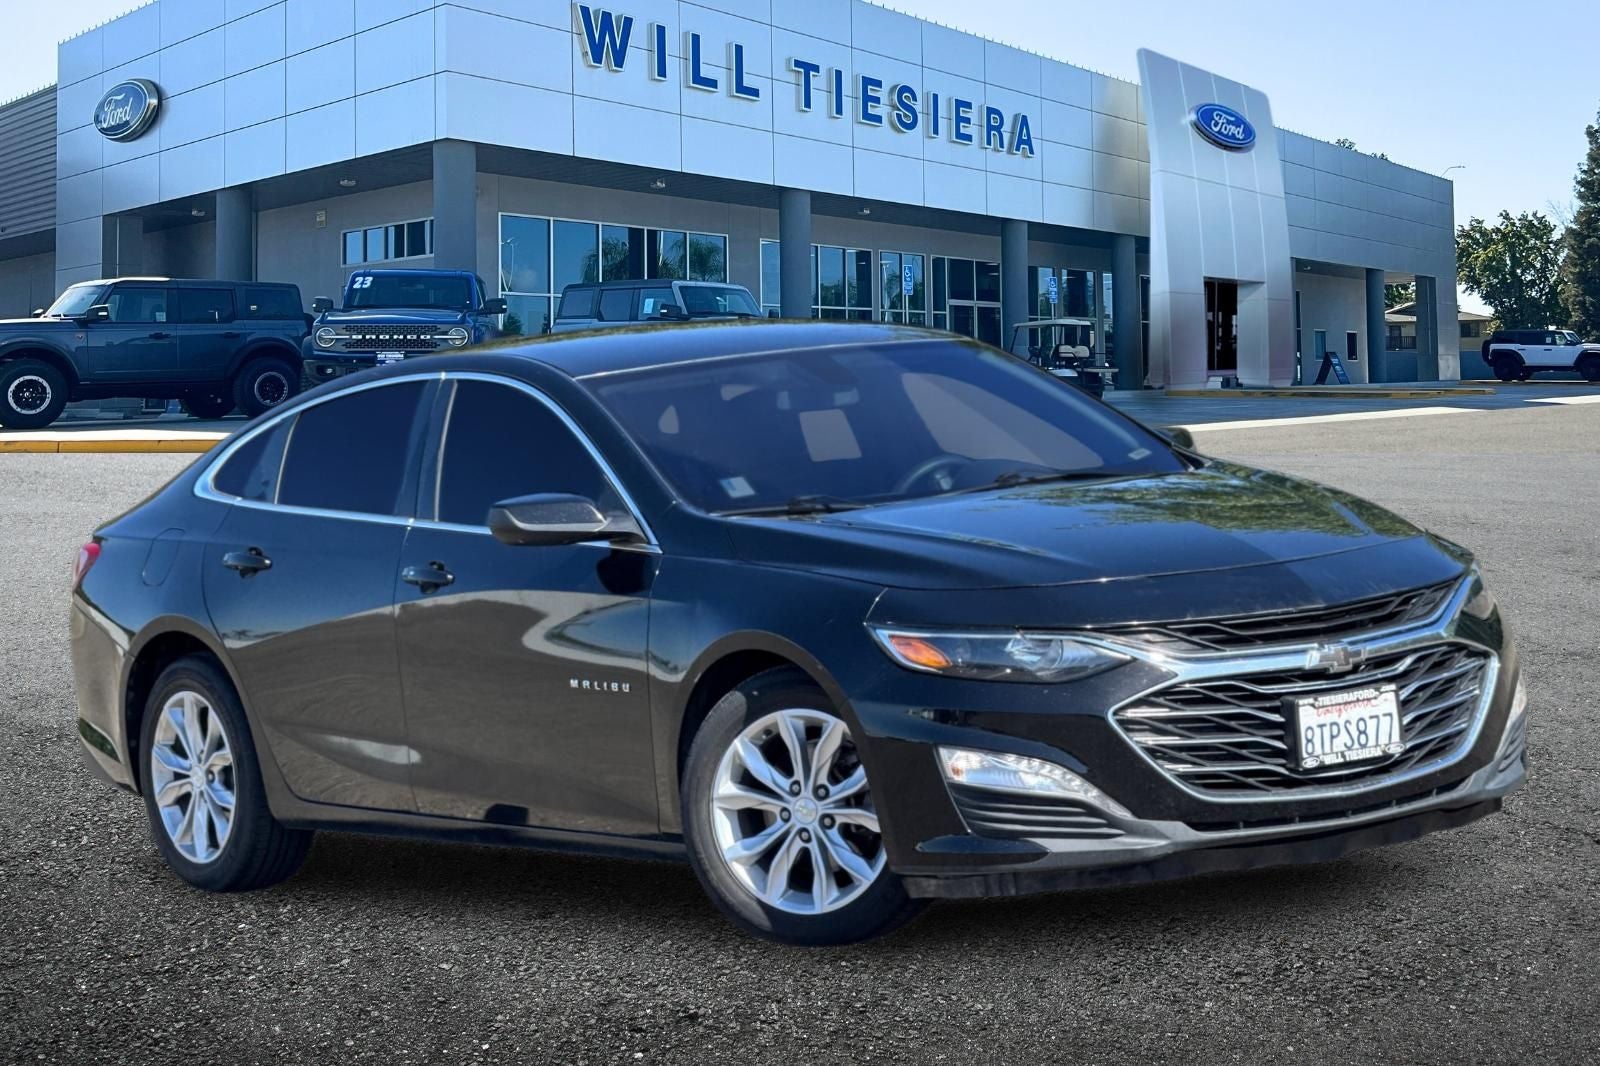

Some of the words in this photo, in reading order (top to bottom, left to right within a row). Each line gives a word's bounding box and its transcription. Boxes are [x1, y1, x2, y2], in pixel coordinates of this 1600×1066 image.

[575, 3, 760, 101] WILL
[788, 57, 1035, 157] TIESIERA
[102, 93, 133, 128] Ford
[1210, 110, 1245, 140] Ford
[352, 276, 373, 289] 23
[569, 678, 631, 693] MALIBU
[1304, 712, 1394, 756] 8TPS877
